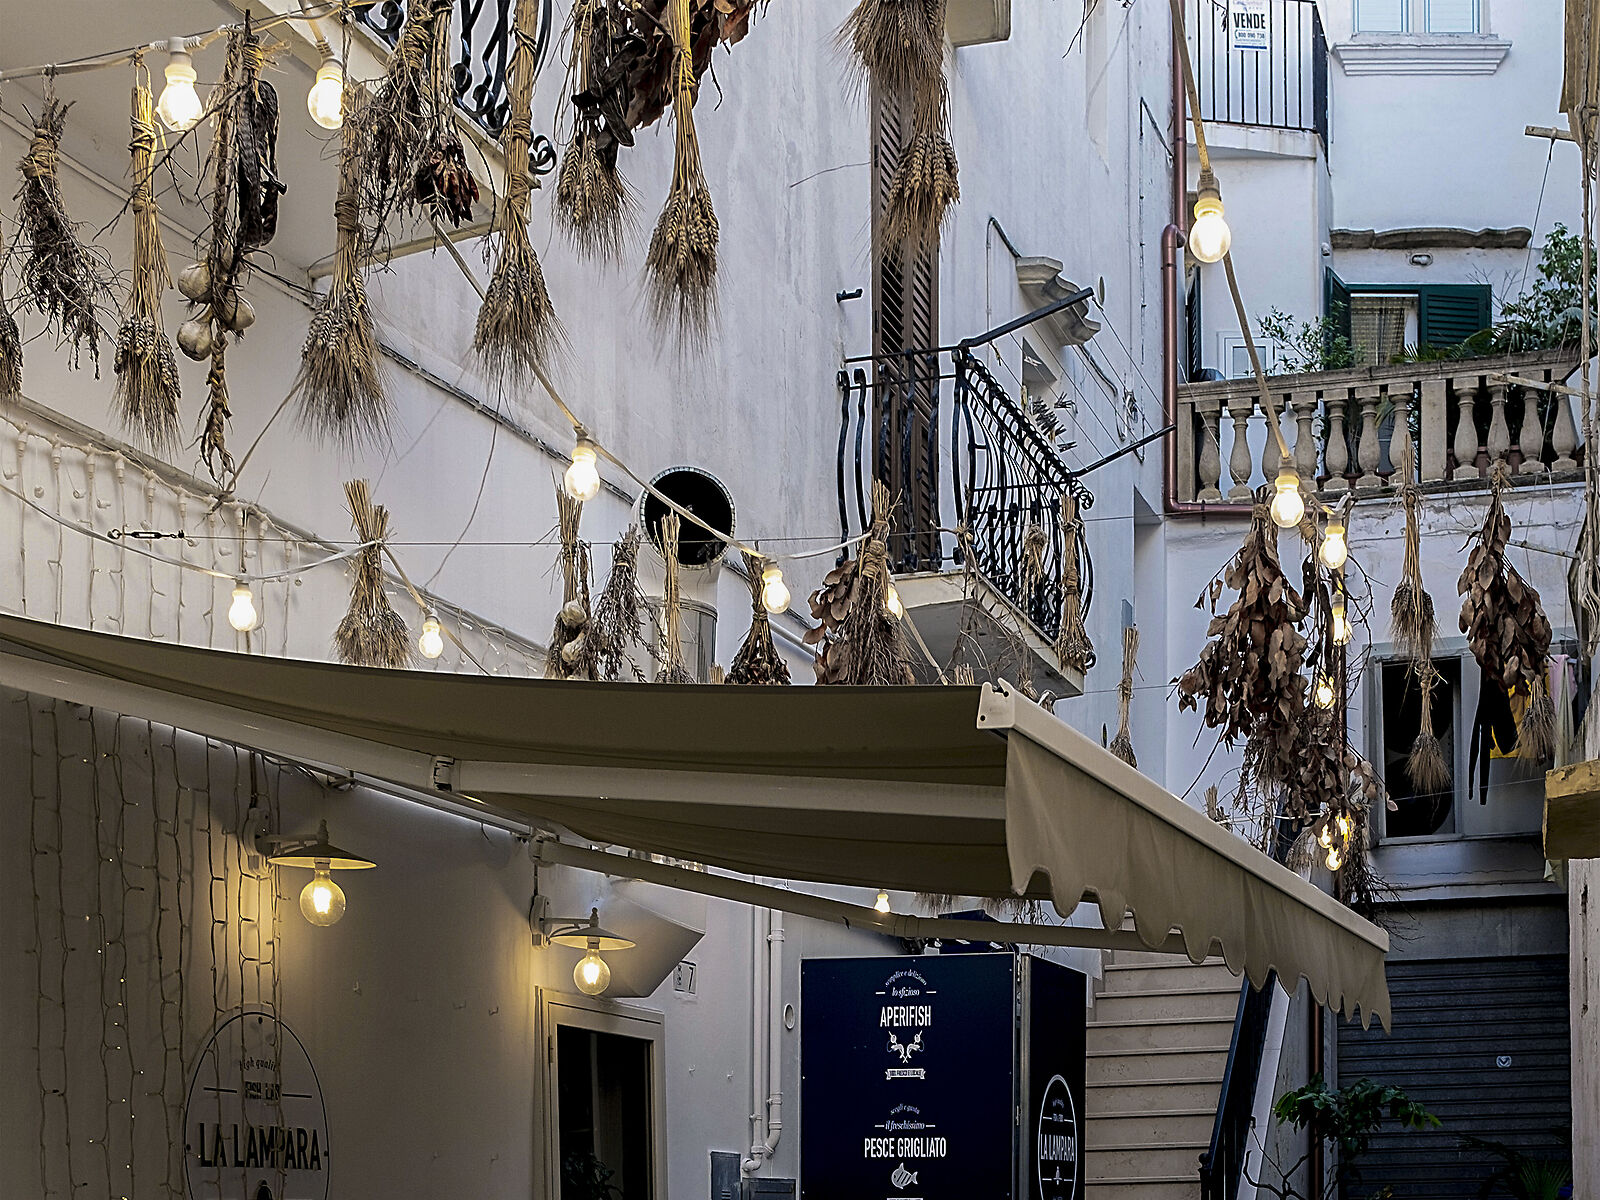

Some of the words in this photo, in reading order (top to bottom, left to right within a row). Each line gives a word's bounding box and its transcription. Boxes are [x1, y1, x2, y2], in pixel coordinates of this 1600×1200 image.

[1233, 12, 1266, 29] VENDE
[880, 1005, 931, 1027] APERIFISH
[199, 1122, 228, 1168] LA
[232, 1123, 322, 1171] LAMPARA
[864, 1137, 895, 1158] PESCE
[897, 1136, 947, 1158] GRIGLIATO
[1040, 1133, 1048, 1160] LA
[1048, 1134, 1075, 1162] LAMPARA
